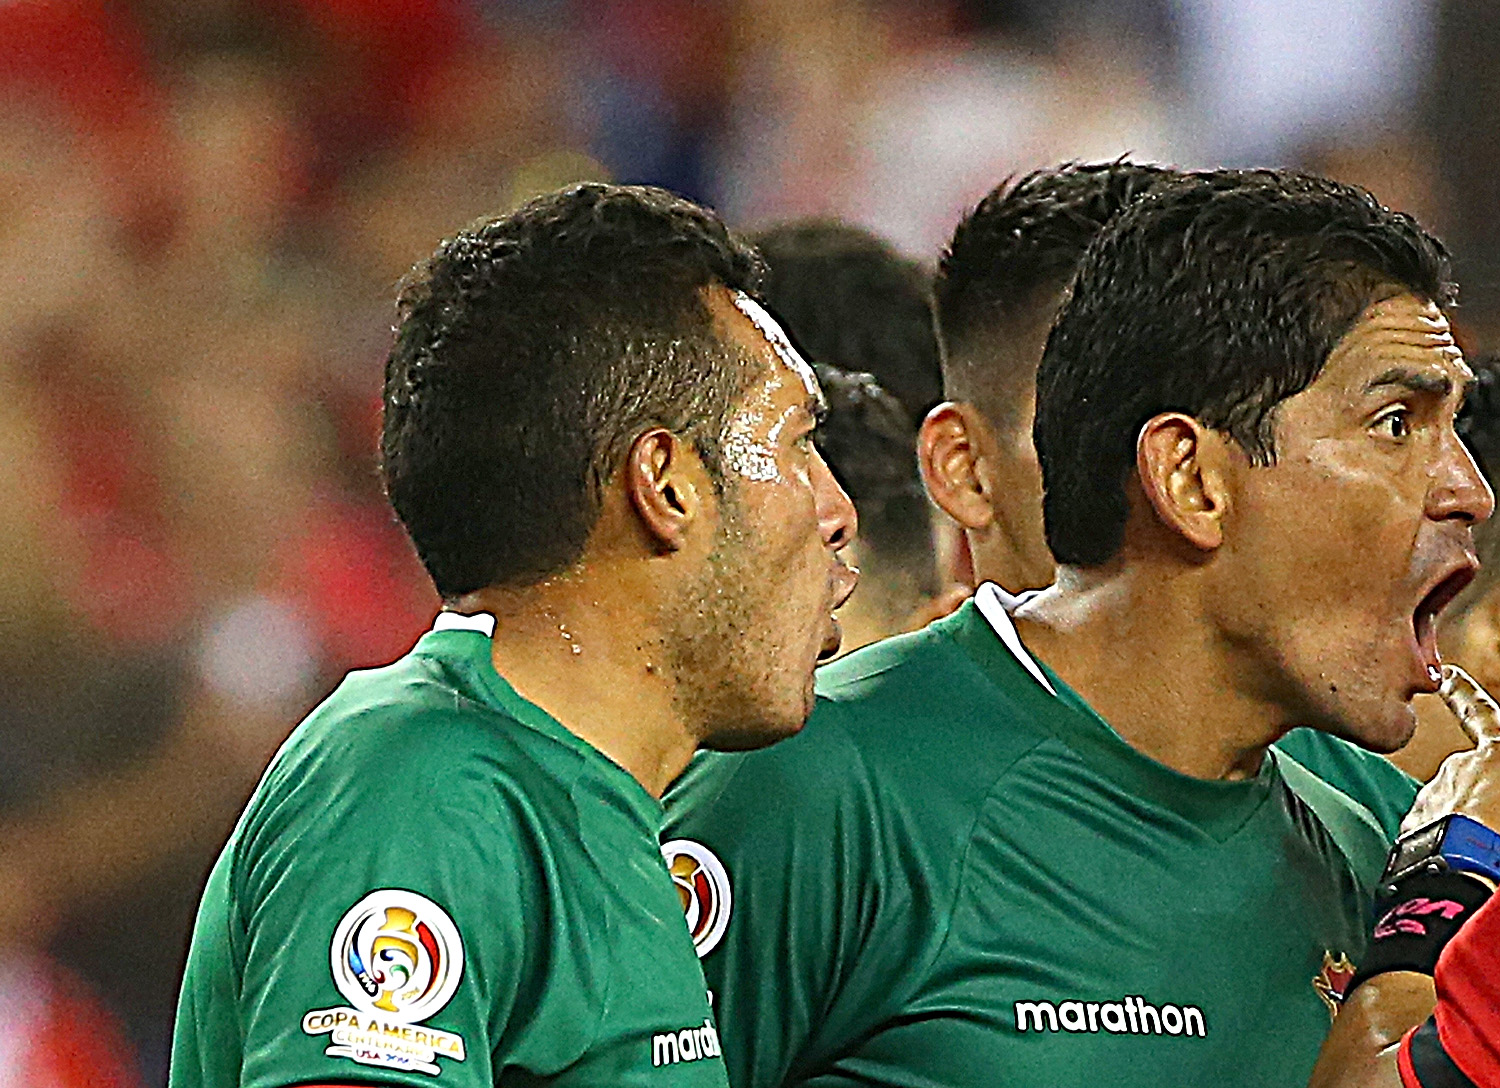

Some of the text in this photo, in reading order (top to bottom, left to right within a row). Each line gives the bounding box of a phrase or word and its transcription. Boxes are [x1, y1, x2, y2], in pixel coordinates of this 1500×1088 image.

[307, 1012, 460, 1053] COPA AMERICA
[1015, 996, 1206, 1037] marathon
